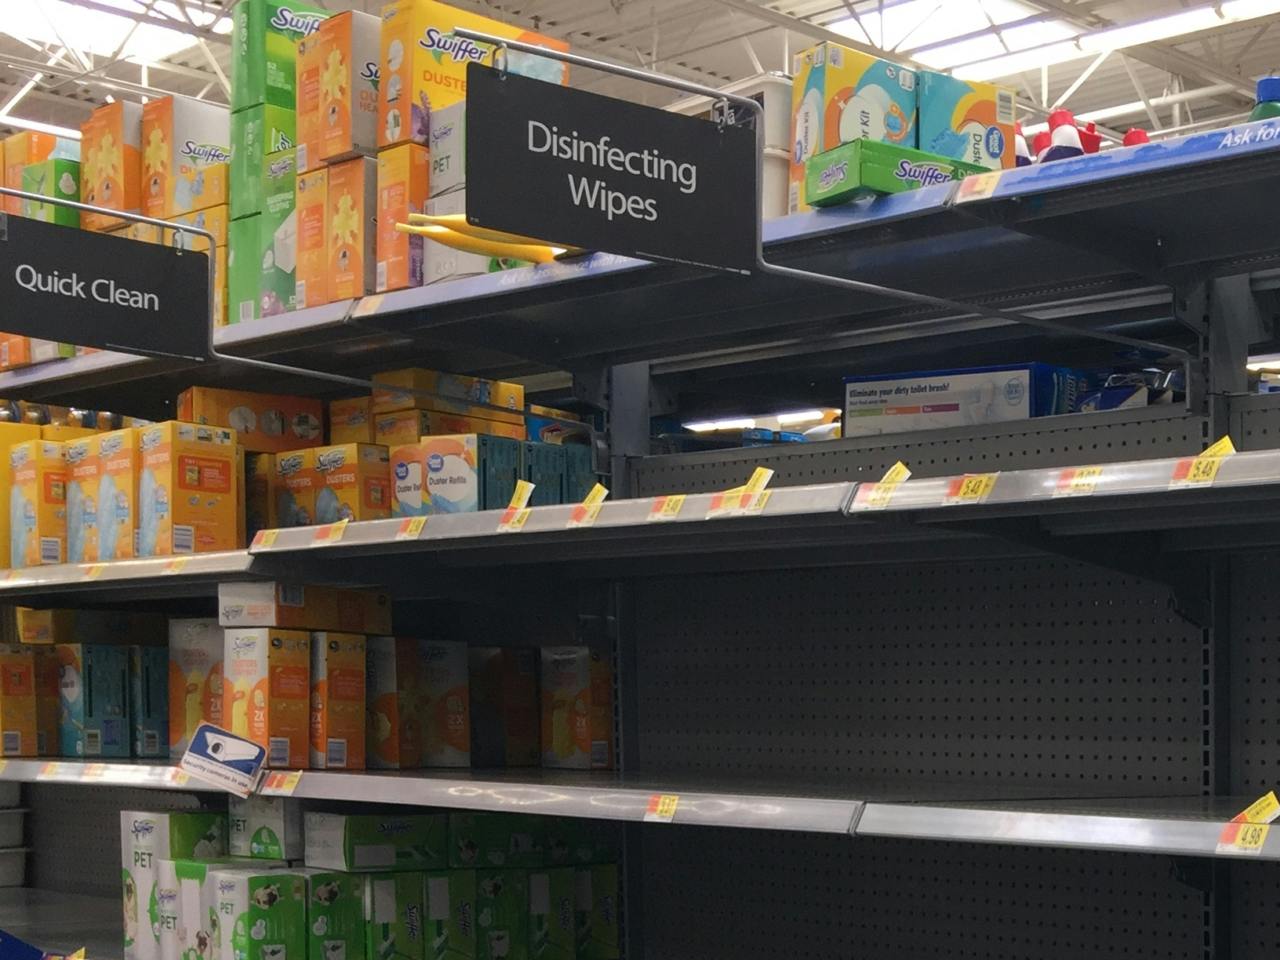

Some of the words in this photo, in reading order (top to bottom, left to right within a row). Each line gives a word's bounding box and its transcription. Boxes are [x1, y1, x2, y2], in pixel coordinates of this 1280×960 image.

[271, 7, 320, 35] Swif
[419, 27, 487, 62] Swiffer
[423, 69, 467, 93] DUSTE
[181, 140, 231, 162] Swiffer
[971, 133, 982, 165] Duste
[1218, 132, 1251, 150] Ask
[432, 155, 451, 172] PET
[527, 119, 698, 194] Disinfecting
[894, 159, 951, 188] Swiffer
[568, 173, 658, 221] Wipes
[15, 264, 87, 299] Quick
[91, 279, 159, 311] Clean
[134, 851, 153, 868] PET
[160, 914, 177, 930] PET
[220, 902, 234, 915] PET
